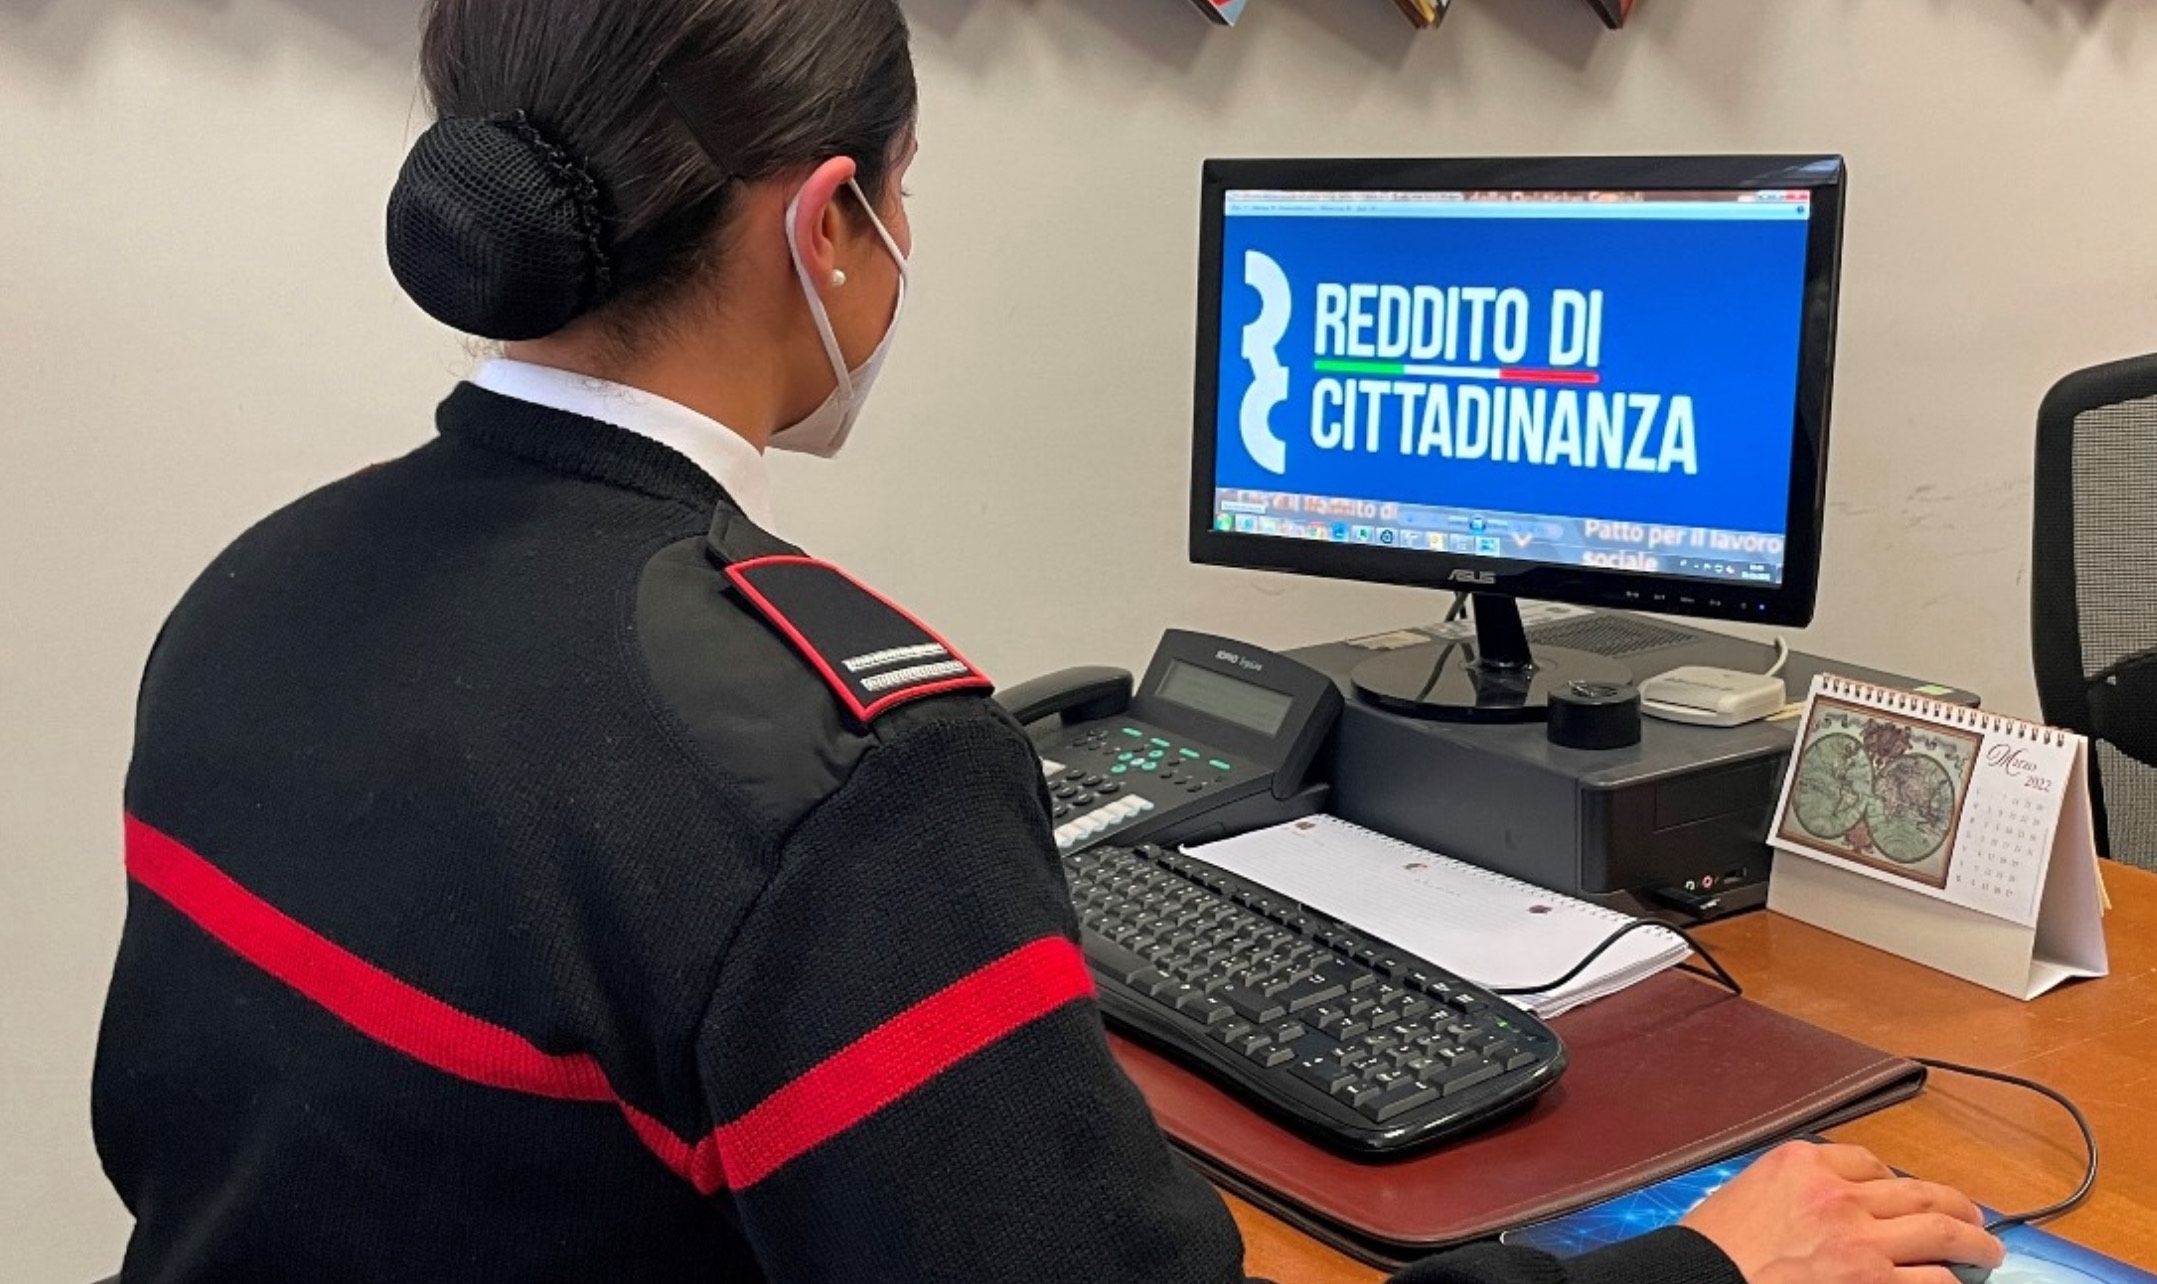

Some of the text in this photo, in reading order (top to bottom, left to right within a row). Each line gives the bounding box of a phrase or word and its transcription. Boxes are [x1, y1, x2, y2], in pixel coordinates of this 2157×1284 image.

[1314, 283, 1604, 367] REDDITO DI
[1310, 377, 1698, 475] CITTADINANZA
[1584, 518, 1643, 542] Patto
[1648, 527, 1687, 548] per
[1710, 530, 1784, 554] lavoro
[1448, 568, 1496, 584] ASUS
[1582, 550, 1659, 573] sociale
[2024, 775, 2052, 792] 2022
